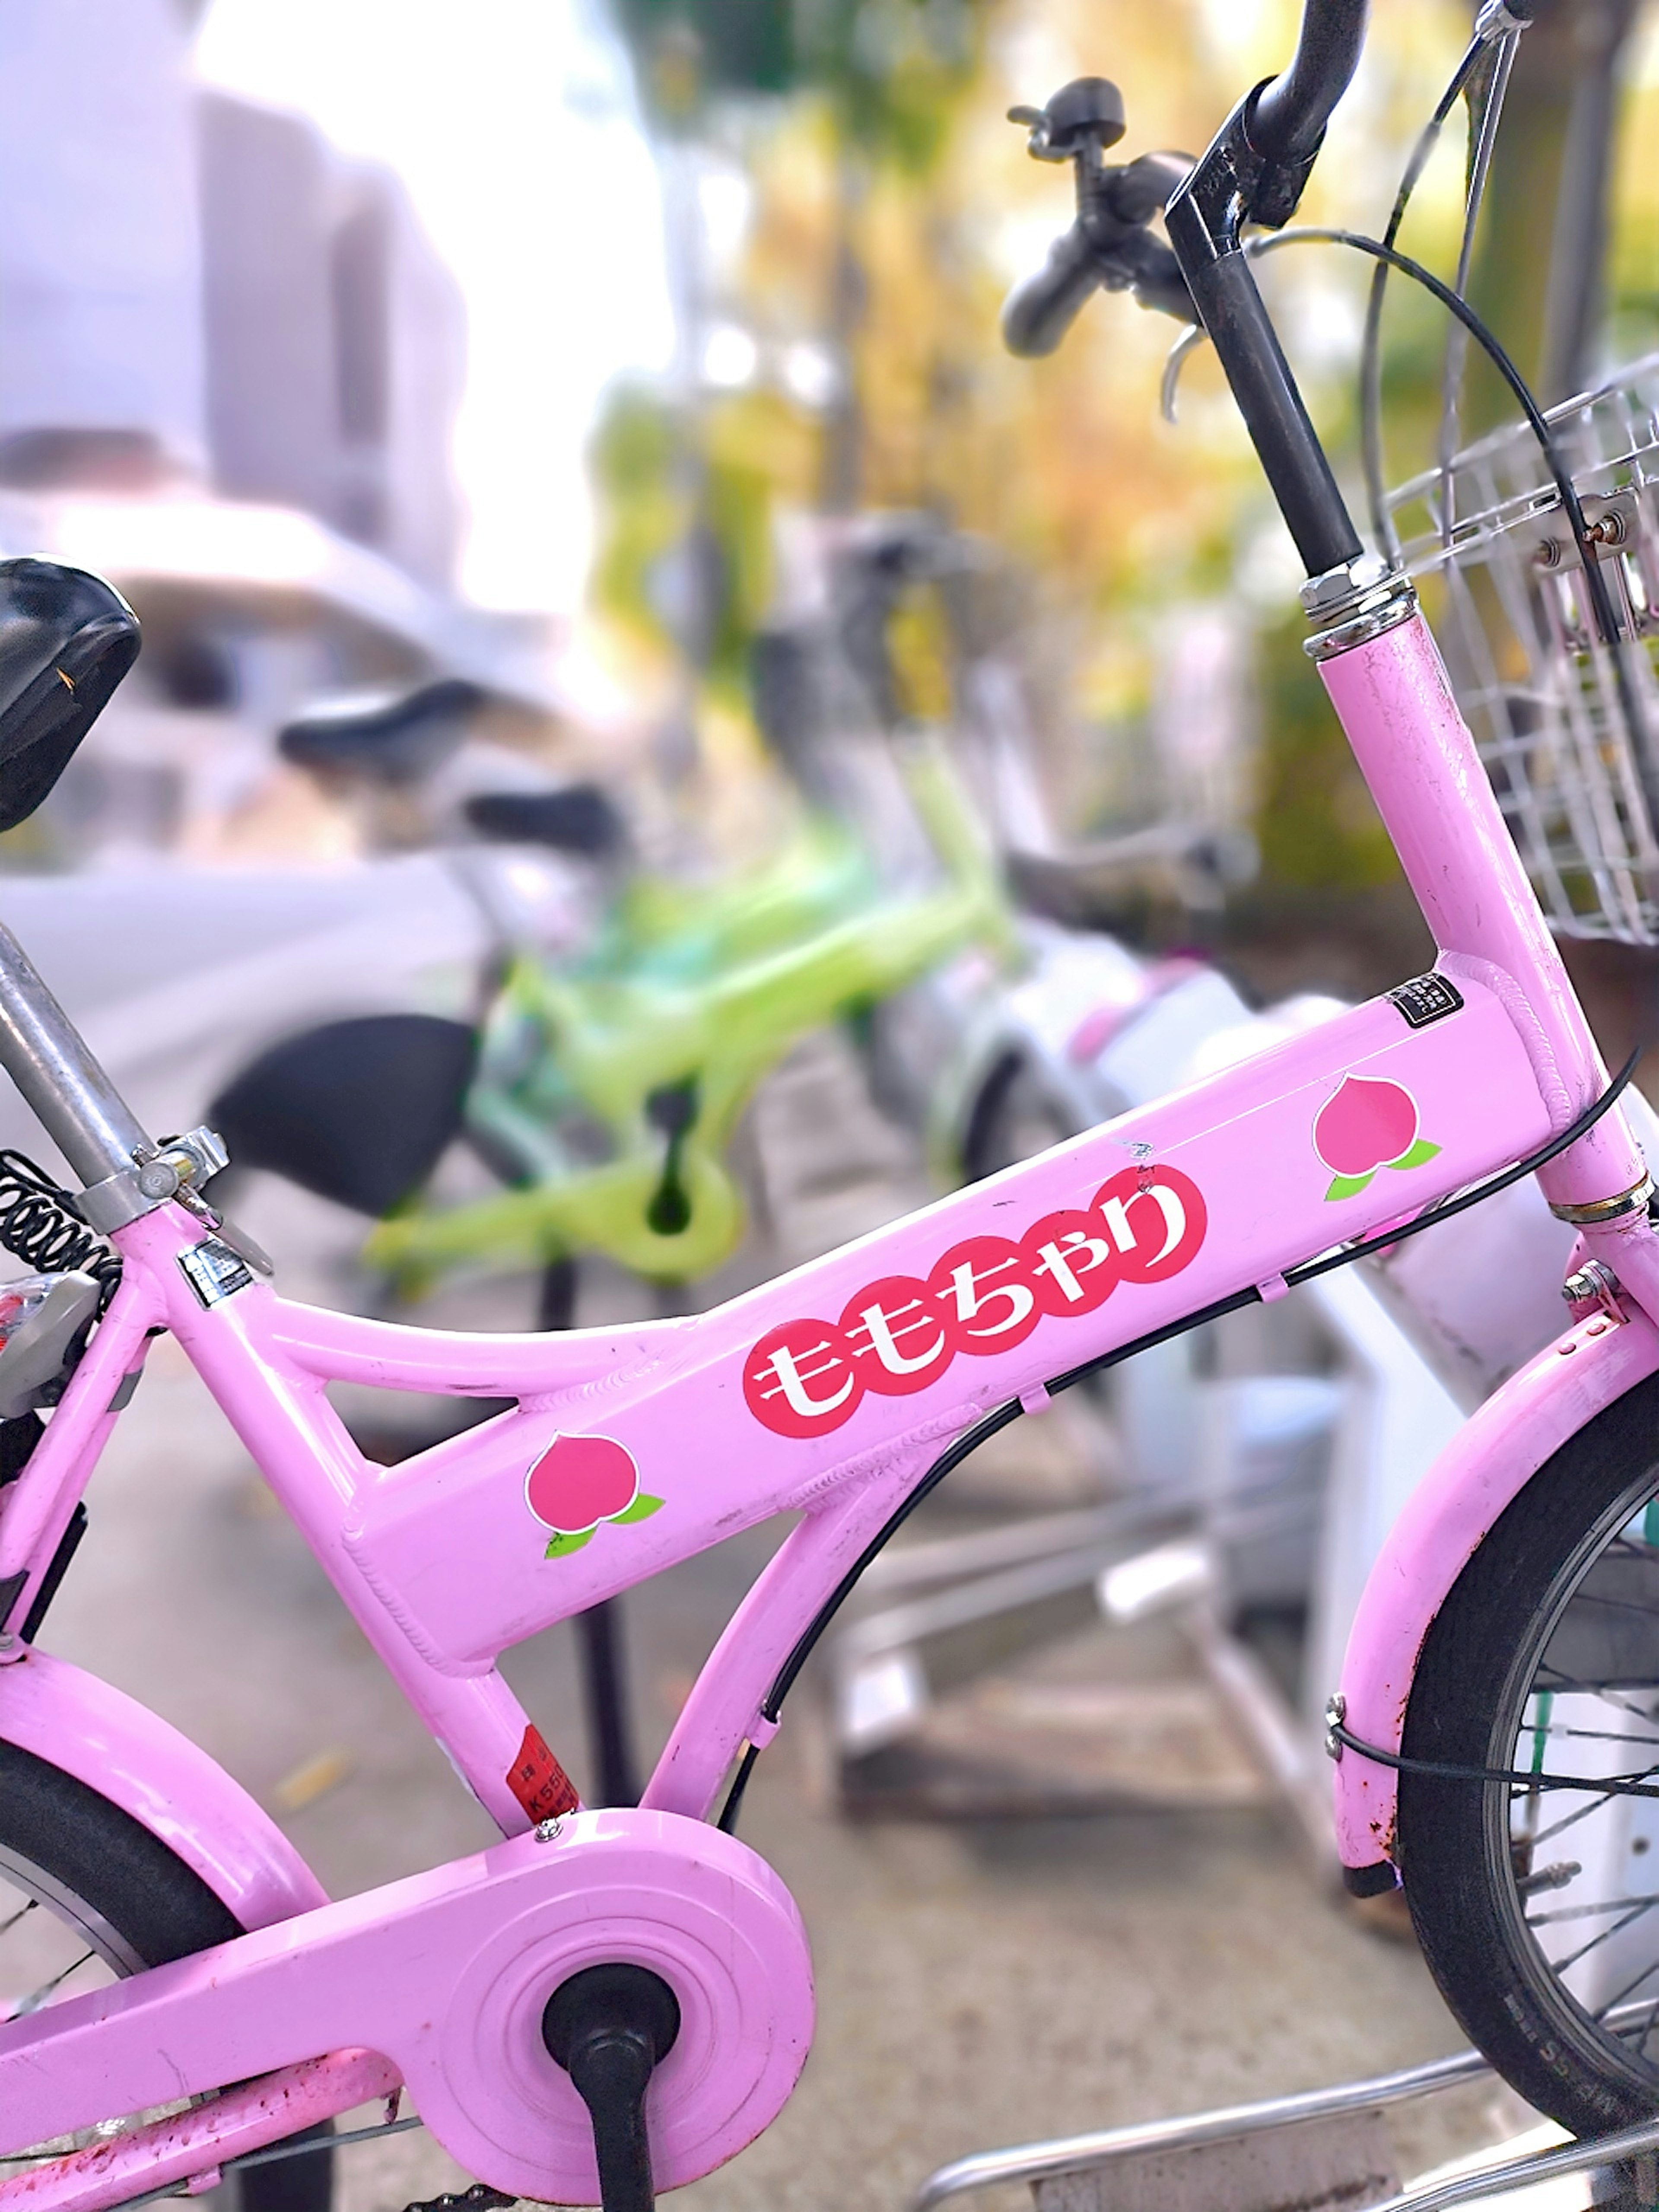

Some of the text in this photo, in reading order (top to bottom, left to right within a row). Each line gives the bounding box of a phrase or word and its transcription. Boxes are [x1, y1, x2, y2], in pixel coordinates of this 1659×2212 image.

[753, 1184, 1186, 1416] ももちゃり
